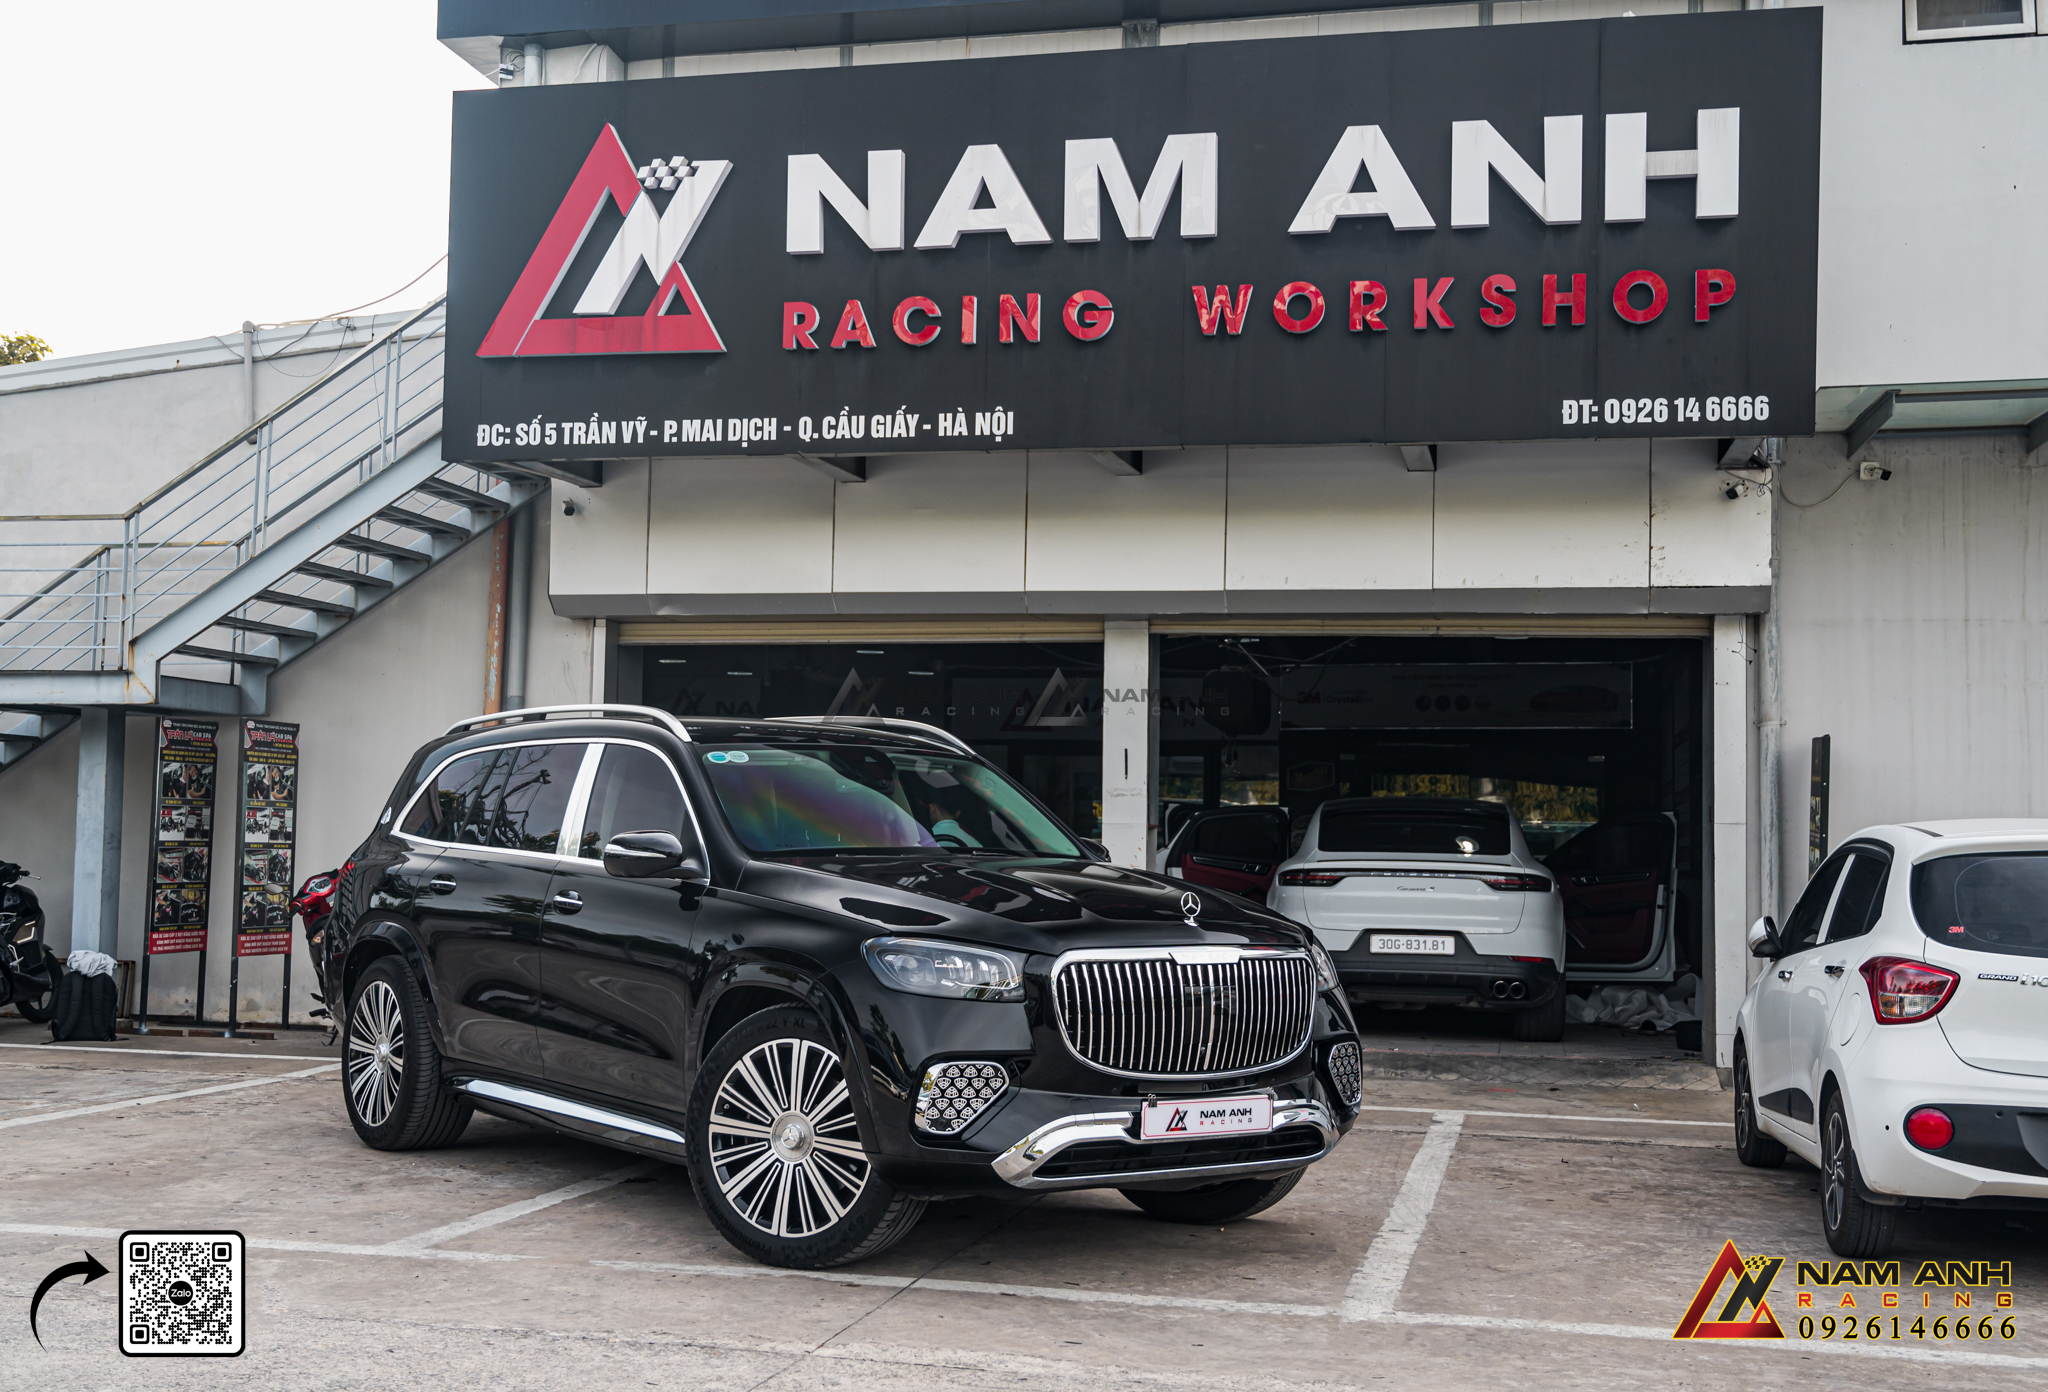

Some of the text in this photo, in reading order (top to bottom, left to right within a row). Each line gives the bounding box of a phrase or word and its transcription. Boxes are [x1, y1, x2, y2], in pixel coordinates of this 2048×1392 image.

[786, 107, 1740, 255] NAM ANH
[782, 269, 1736, 351] RACING WORKSHOP
[1562, 395, 1770, 424] ĐT: 0926 14 6666
[477, 423, 511, 447] ĐC:
[515, 414, 542, 446] SỐ
[544, 423, 557, 446] 5
[562, 412, 617, 445] TRẦN
[621, 416, 648, 443] VỸ
[682, 419, 723, 442] MAI
[727, 418, 777, 447] DỊCH
[799, 416, 819, 442] Q.
[822, 405, 865, 440] CẦU
[870, 404, 919, 438] GIẤY
[938, 407, 968, 437] HÀ
[975, 406, 1014, 442] NỘI
[1979, 973, 2017, 981] GRAND
[1200, 1108, 1252, 1118] NAM ANH
[1200, 1117, 1252, 1126] RACING
